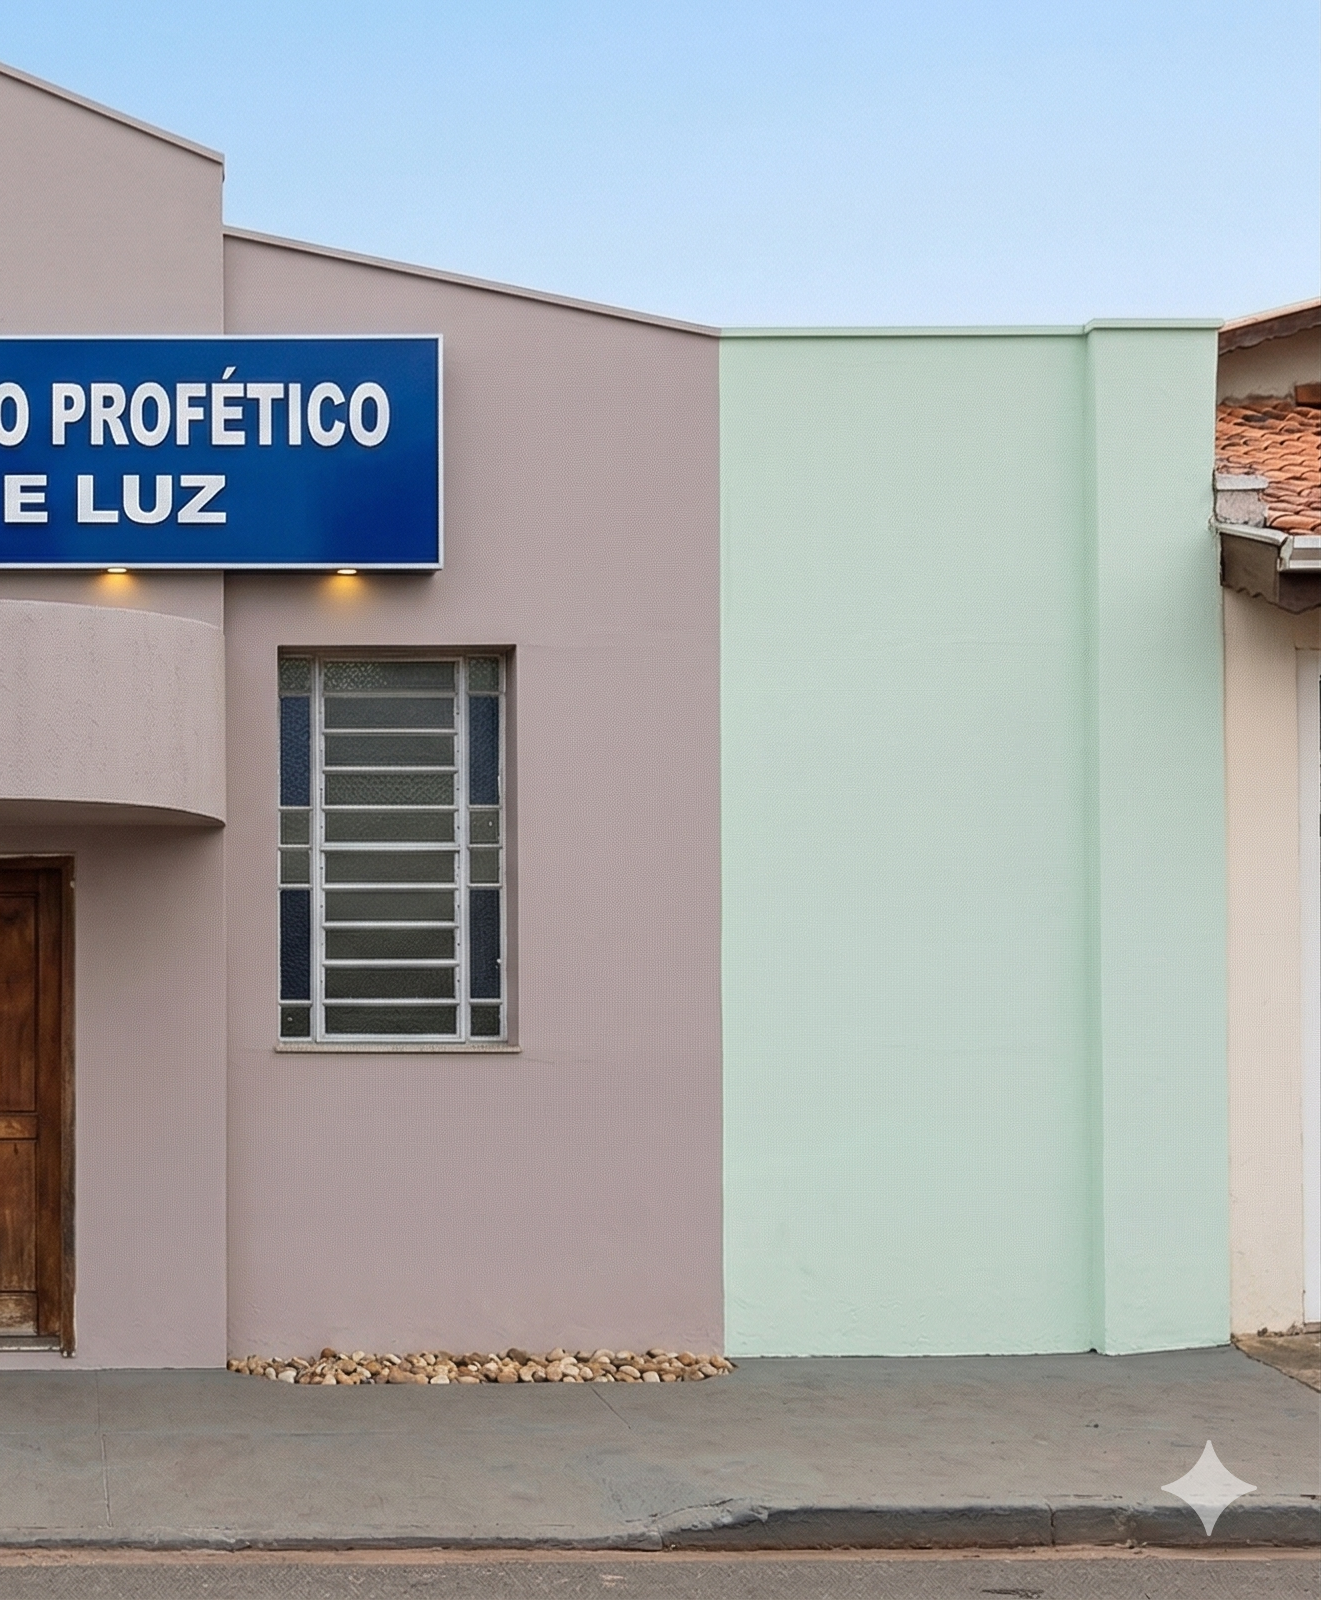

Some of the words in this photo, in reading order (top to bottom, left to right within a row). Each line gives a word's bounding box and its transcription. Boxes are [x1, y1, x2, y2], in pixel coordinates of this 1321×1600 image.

[52, 366, 390, 447] PROFÉTICO
[3, 474, 49, 523] E
[77, 474, 227, 524] LUZ
